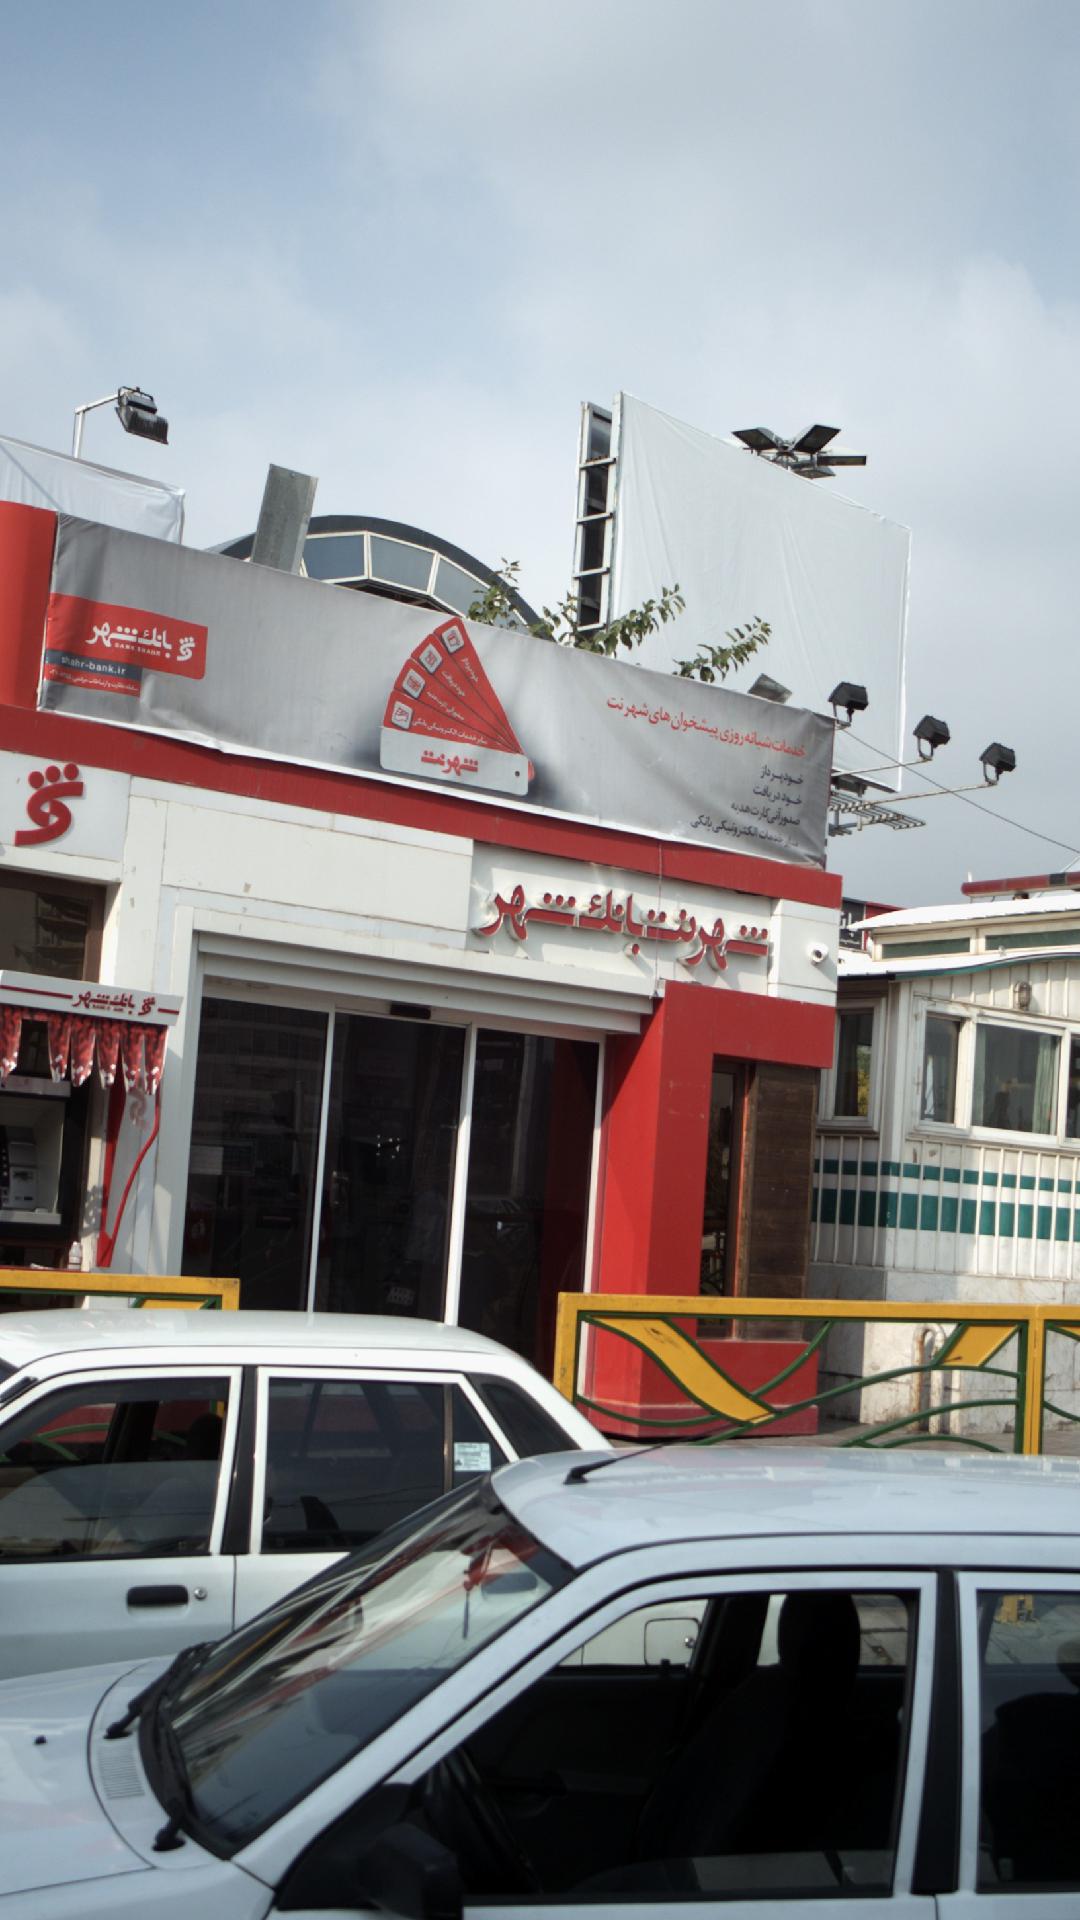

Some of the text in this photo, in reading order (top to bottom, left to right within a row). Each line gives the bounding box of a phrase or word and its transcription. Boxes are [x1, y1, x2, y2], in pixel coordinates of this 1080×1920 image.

[85, 621, 172, 658] بانک شهر
[61, 656, 127, 675] shahr-bank.ir
[772, 738, 806, 757] خدمات
[474, 884, 576, 941] شهر
[72, 991, 110, 1009] شهر
